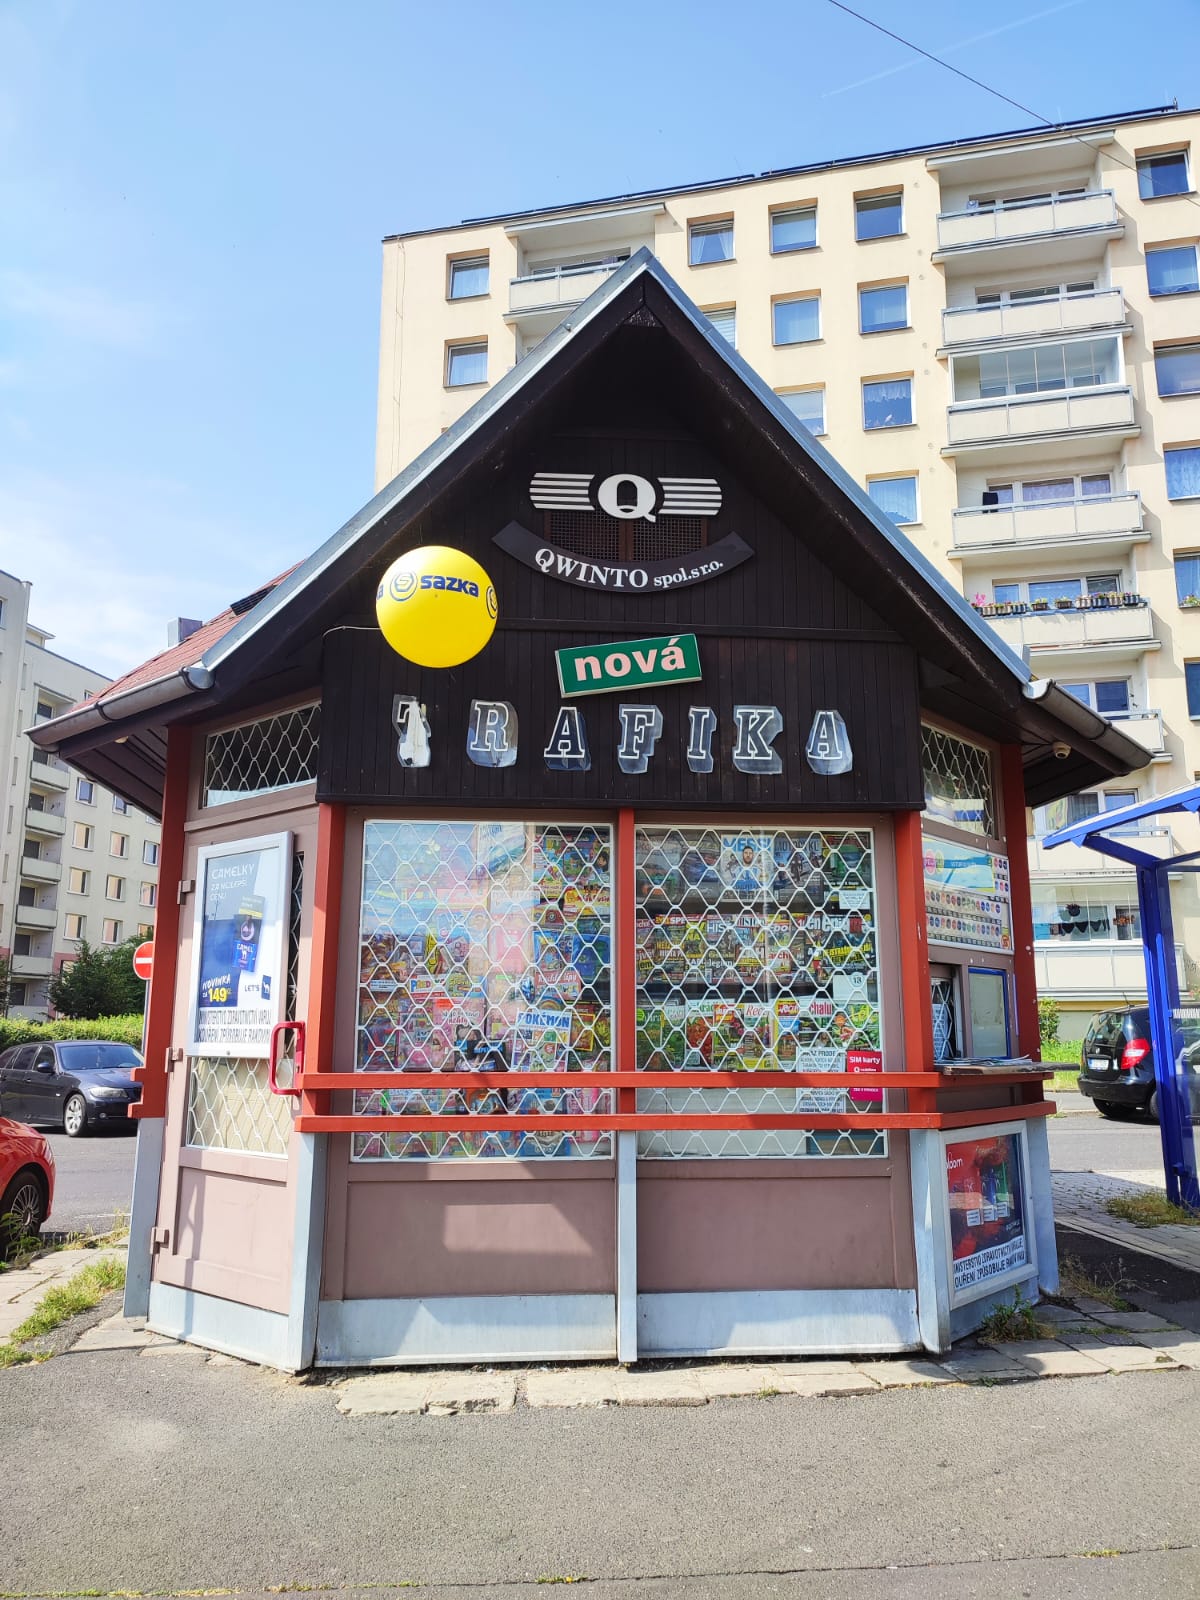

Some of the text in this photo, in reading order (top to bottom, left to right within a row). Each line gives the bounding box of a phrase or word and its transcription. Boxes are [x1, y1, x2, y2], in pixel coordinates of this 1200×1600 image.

[598, 473, 656, 523] Q
[535, 548, 648, 588] QWINTO
[574, 640, 686, 682] nová
[211, 863, 255, 880] CAMELKY
[202, 974, 232, 991] NOVINKA
[208, 986, 228, 1003] 149
[518, 1012, 570, 1028] POKÉMON
[849, 1056, 862, 1064] SIM
